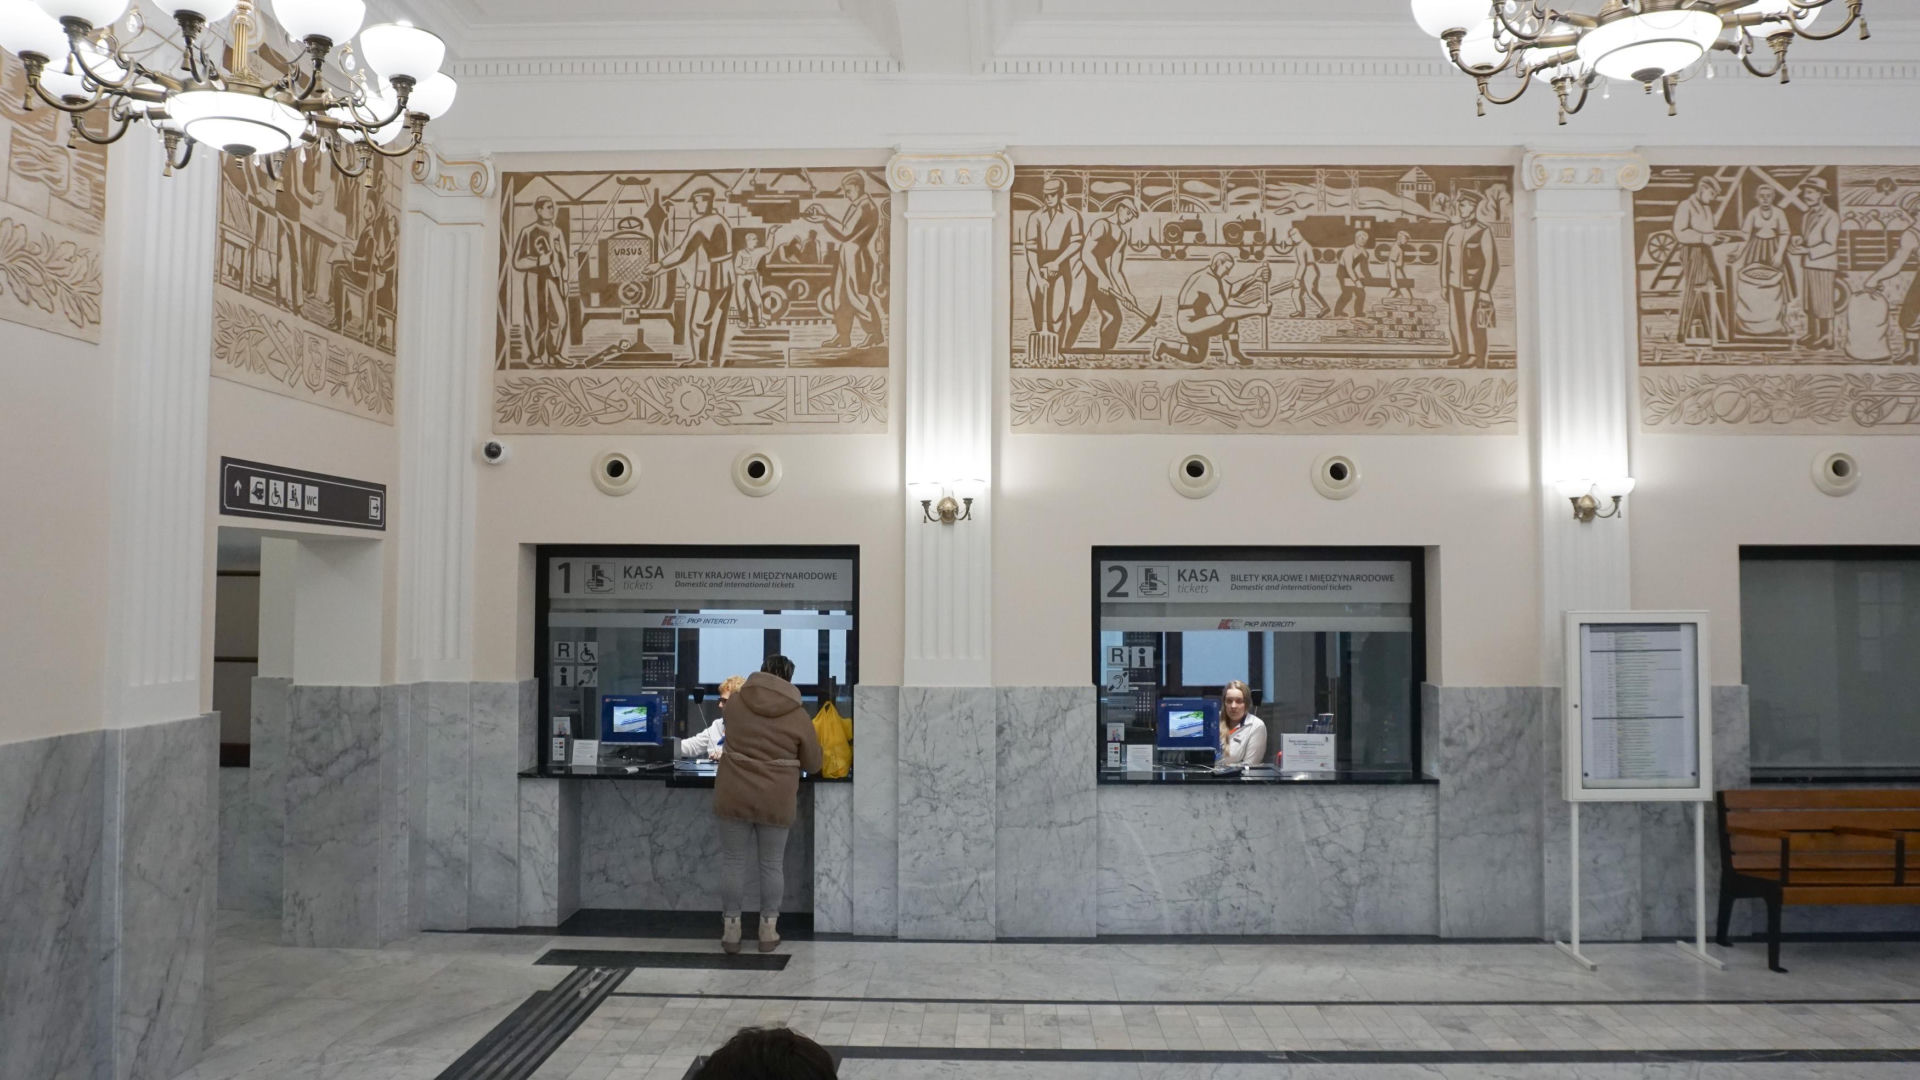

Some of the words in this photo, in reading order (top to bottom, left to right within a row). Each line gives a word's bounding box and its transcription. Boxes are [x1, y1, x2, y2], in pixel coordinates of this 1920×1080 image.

[614, 248, 642, 256] URSUS
[306, 496, 317, 506] WC
[623, 565, 664, 579] KASA
[674, 571, 702, 580] BILETY
[705, 571, 746, 580] KRAJOWE
[753, 571, 838, 581] MIĘDZYNARODOWE
[1177, 569, 1219, 582] KASA
[557, 562, 571, 594] 1
[1106, 565, 1129, 598] 2
[1230, 574, 1259, 582] BILETY
[1261, 574, 1302, 583] KRAJOWE
[1309, 574, 1395, 584] MIĘDZYNARODOWE
[623, 580, 653, 591] tickets
[674, 580, 708, 588] Domestic
[1177, 583, 1209, 594] tickets
[1230, 583, 1263, 591] Domestic
[1280, 583, 1328, 591] international
[1329, 583, 1352, 591] tickets
[1244, 620, 1259, 628] PKP
[1260, 620, 1296, 628] INTERCITY
[558, 643, 570, 657] R
[1112, 648, 1124, 662] R
